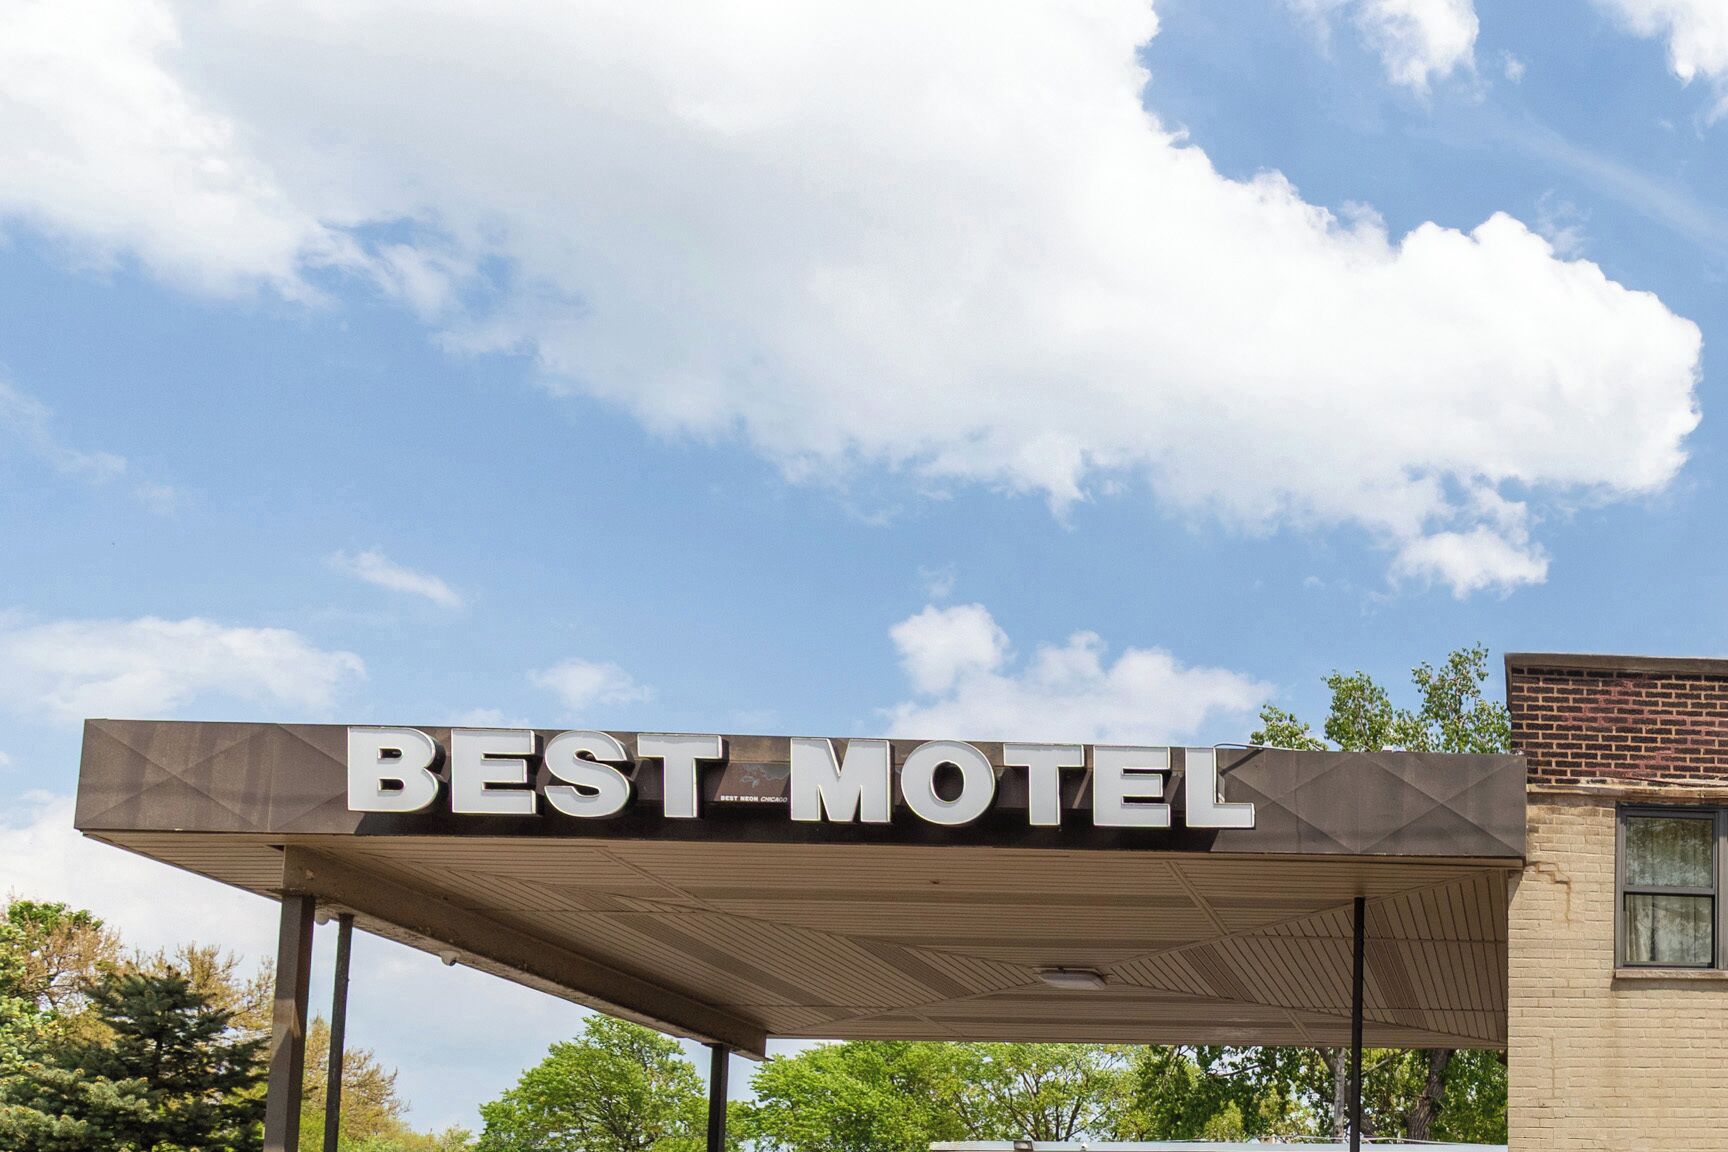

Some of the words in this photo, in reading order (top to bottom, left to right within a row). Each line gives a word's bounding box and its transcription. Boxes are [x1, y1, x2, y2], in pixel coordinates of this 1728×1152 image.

[347, 726, 722, 818] BEST
[790, 737, 1256, 829] MOTEL
[740, 795, 759, 803] NEON
